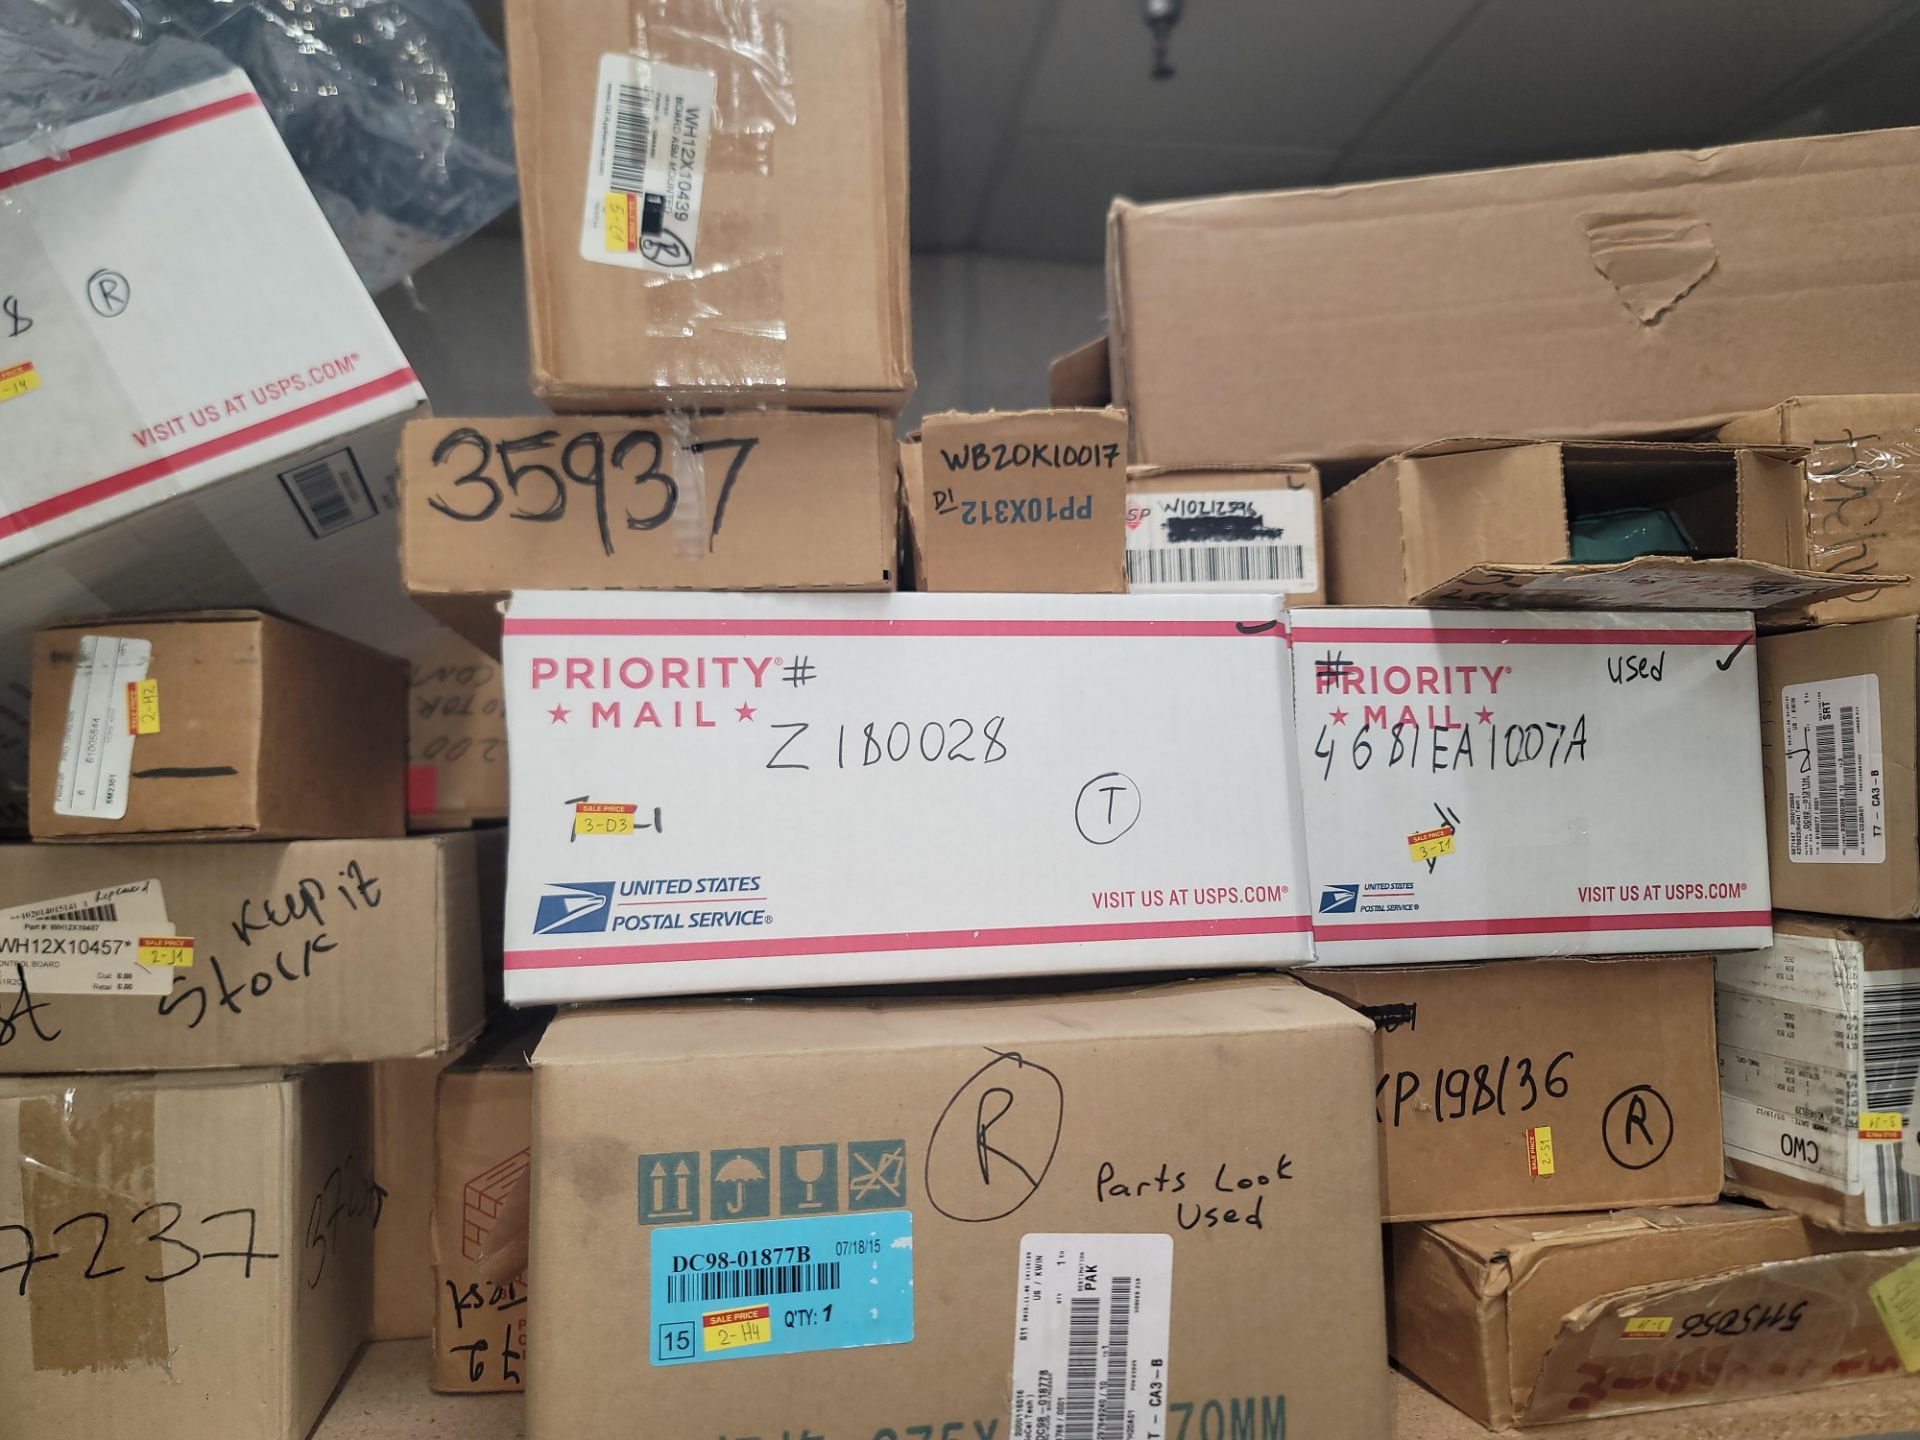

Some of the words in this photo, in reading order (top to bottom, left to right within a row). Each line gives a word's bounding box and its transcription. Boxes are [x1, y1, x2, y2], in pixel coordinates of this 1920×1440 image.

[674, 107, 700, 222] WH12X10439
[133, 417, 186, 448] VISIT
[190, 405, 221, 429] US
[224, 395, 248, 416] AT
[941, 442, 1121, 472] WB20K10017
[428, 427, 759, 556] 35937
[961, 495, 1092, 525] PP10X312
[782, 655, 817, 688] #
[592, 701, 716, 728] MAIL
[1364, 705, 1461, 729] MAIL
[1822, 701, 1832, 720] SRT
[583, 804, 603, 812] SALE
[584, 818, 628, 832] 3-D3
[1872, 822, 1882, 838] T7
[1412, 834, 1428, 843] SALE
[620, 879, 692, 897] UNITED
[696, 876, 761, 893] STATES
[1390, 882, 1414, 890] STATES
[1578, 885, 1614, 903] VISIT
[1620, 885, 1640, 902] US
[1643, 885, 1662, 901] AT
[1092, 890, 1136, 909] VISIT
[1141, 890, 1165, 908] US
[1168, 889, 1188, 906] AT
[1360, 904, 1385, 912] POSTAL
[612, 913, 684, 931] POSTAL
[31, 960, 60, 968] BOARD
[1780, 1133, 1819, 1164] CWO
[1098, 1161, 1186, 1202] Parts
[1215, 1153, 1293, 1192] Look
[1177, 1195, 1263, 1230] Used
[672, 1245, 811, 1273] DC98-01877B
[835, 1238, 881, 1256] 07/18/15
[1034, 1255, 1043, 1277] KWIN
[1084, 1265, 1098, 1291] PAK
[709, 1314, 733, 1326] SALE
[734, 1309, 759, 1322] PRICE
[784, 1309, 818, 1328] Q'TY:
[822, 1304, 833, 1322] 1
[664, 1330, 690, 1351] 15
